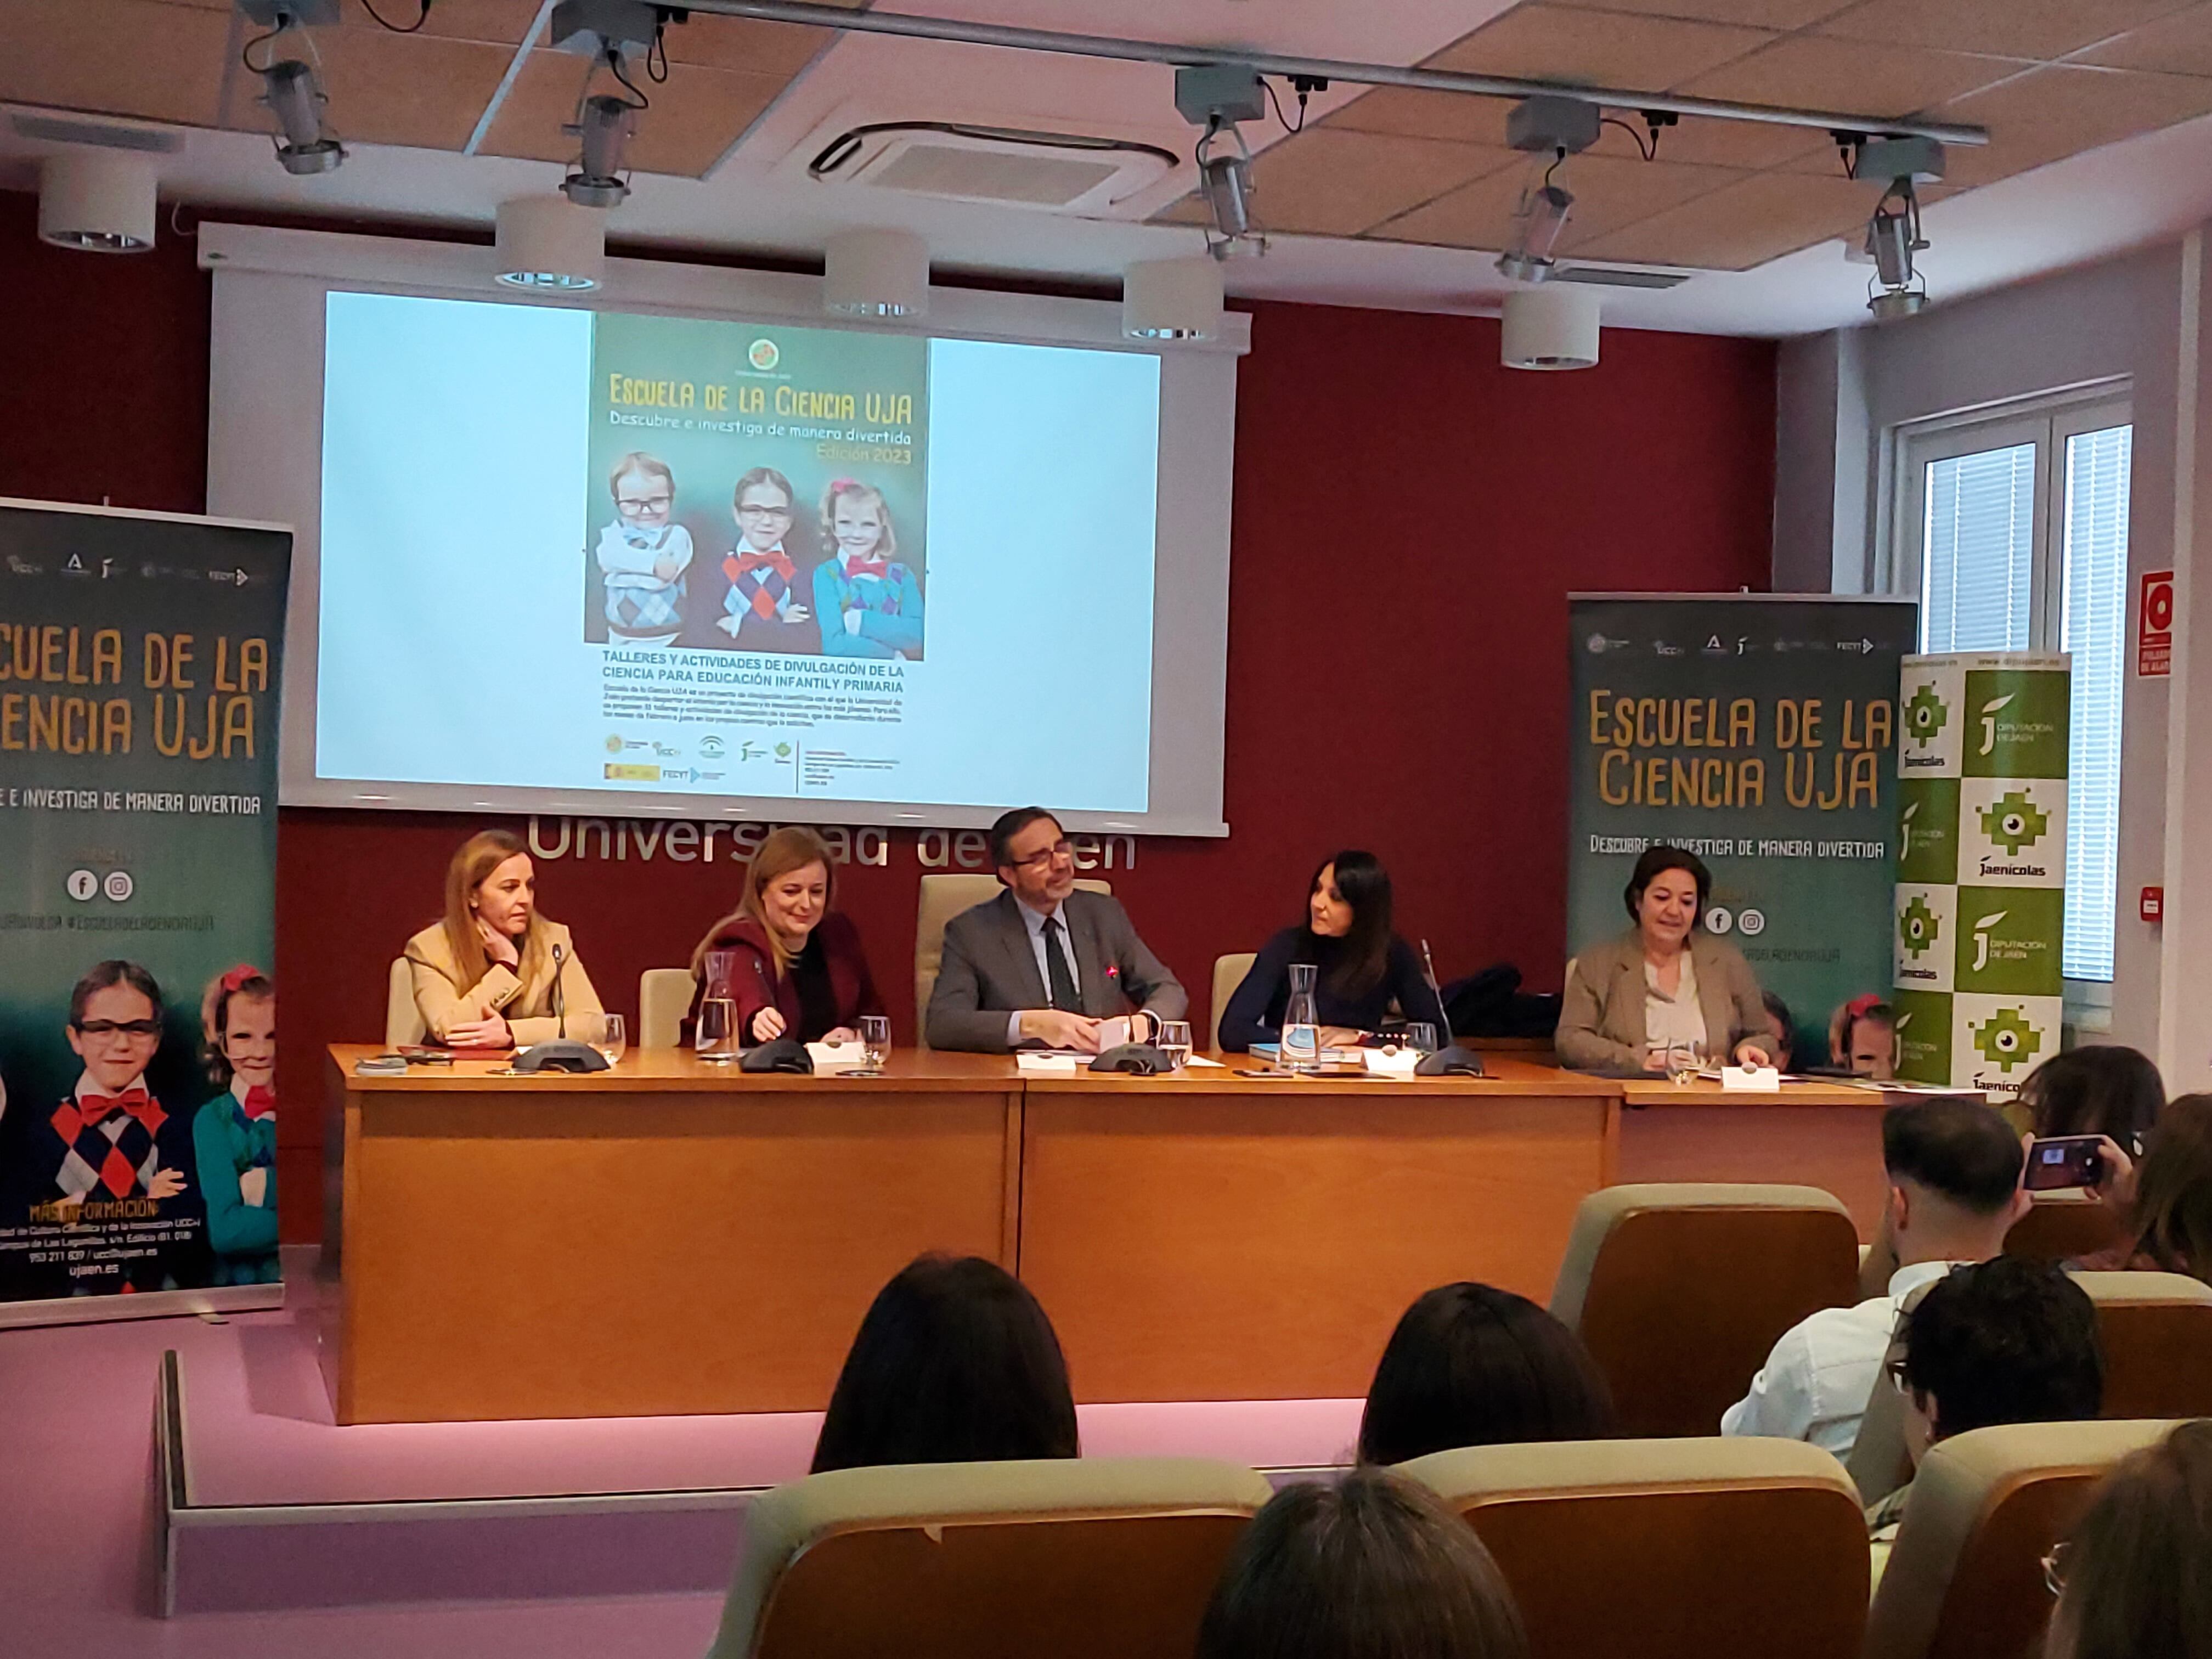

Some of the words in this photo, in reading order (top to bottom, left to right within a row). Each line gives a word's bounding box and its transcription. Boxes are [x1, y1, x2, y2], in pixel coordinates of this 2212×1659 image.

[610, 373, 695, 408] ESCUELA
[704, 385, 728, 411] DE
[739, 387, 765, 414] LA
[775, 385, 855, 420] CIENCIA
[865, 392, 912, 425] UJA
[610, 410, 680, 429] Descubre
[684, 419, 693, 430] e
[698, 419, 763, 437] investiga
[768, 422, 785, 437] de
[790, 427, 842, 441] manera
[847, 430, 912, 445] divertida
[816, 444, 870, 462] Edición
[873, 448, 912, 464] 2023
[144, 633, 195, 689] DE
[215, 636, 268, 692] LA
[602, 650, 667, 665] TALLERES
[669, 653, 678, 665] Y
[680, 654, 762, 670] ACTIVIDADES
[765, 659, 781, 671] DE
[784, 660, 866, 676] DIVULGACIÓN
[869, 664, 885, 676] DE
[888, 665, 904, 678] LA
[602, 667, 654, 680] CIENCIA
[658, 669, 693, 682] PARA
[697, 671, 772, 686] EDUCACIÓN
[844, 679, 904, 693] PRIMARIA
[154, 692, 255, 760] UJA
[1590, 689, 1754, 749] ESCUELA
[1776, 699, 1822, 749] DE
[1842, 699, 1892, 749] LA
[1599, 748, 1765, 809] CIENCIA
[1786, 752, 1878, 810] UJA
[10, 789, 18, 806] E
[23, 789, 98, 809] INVESTIGA
[103, 792, 121, 810] DE
[126, 793, 184, 812] MANERA
[189, 795, 261, 815] DIVERTIDA
[528, 816, 888, 866] Universad
[1667, 838, 1733, 856] VESTIGA
[1739, 839, 1753, 856] DE
[1758, 840, 1812, 857] MANERA
[1818, 842, 1884, 859] DIVERTIDA
